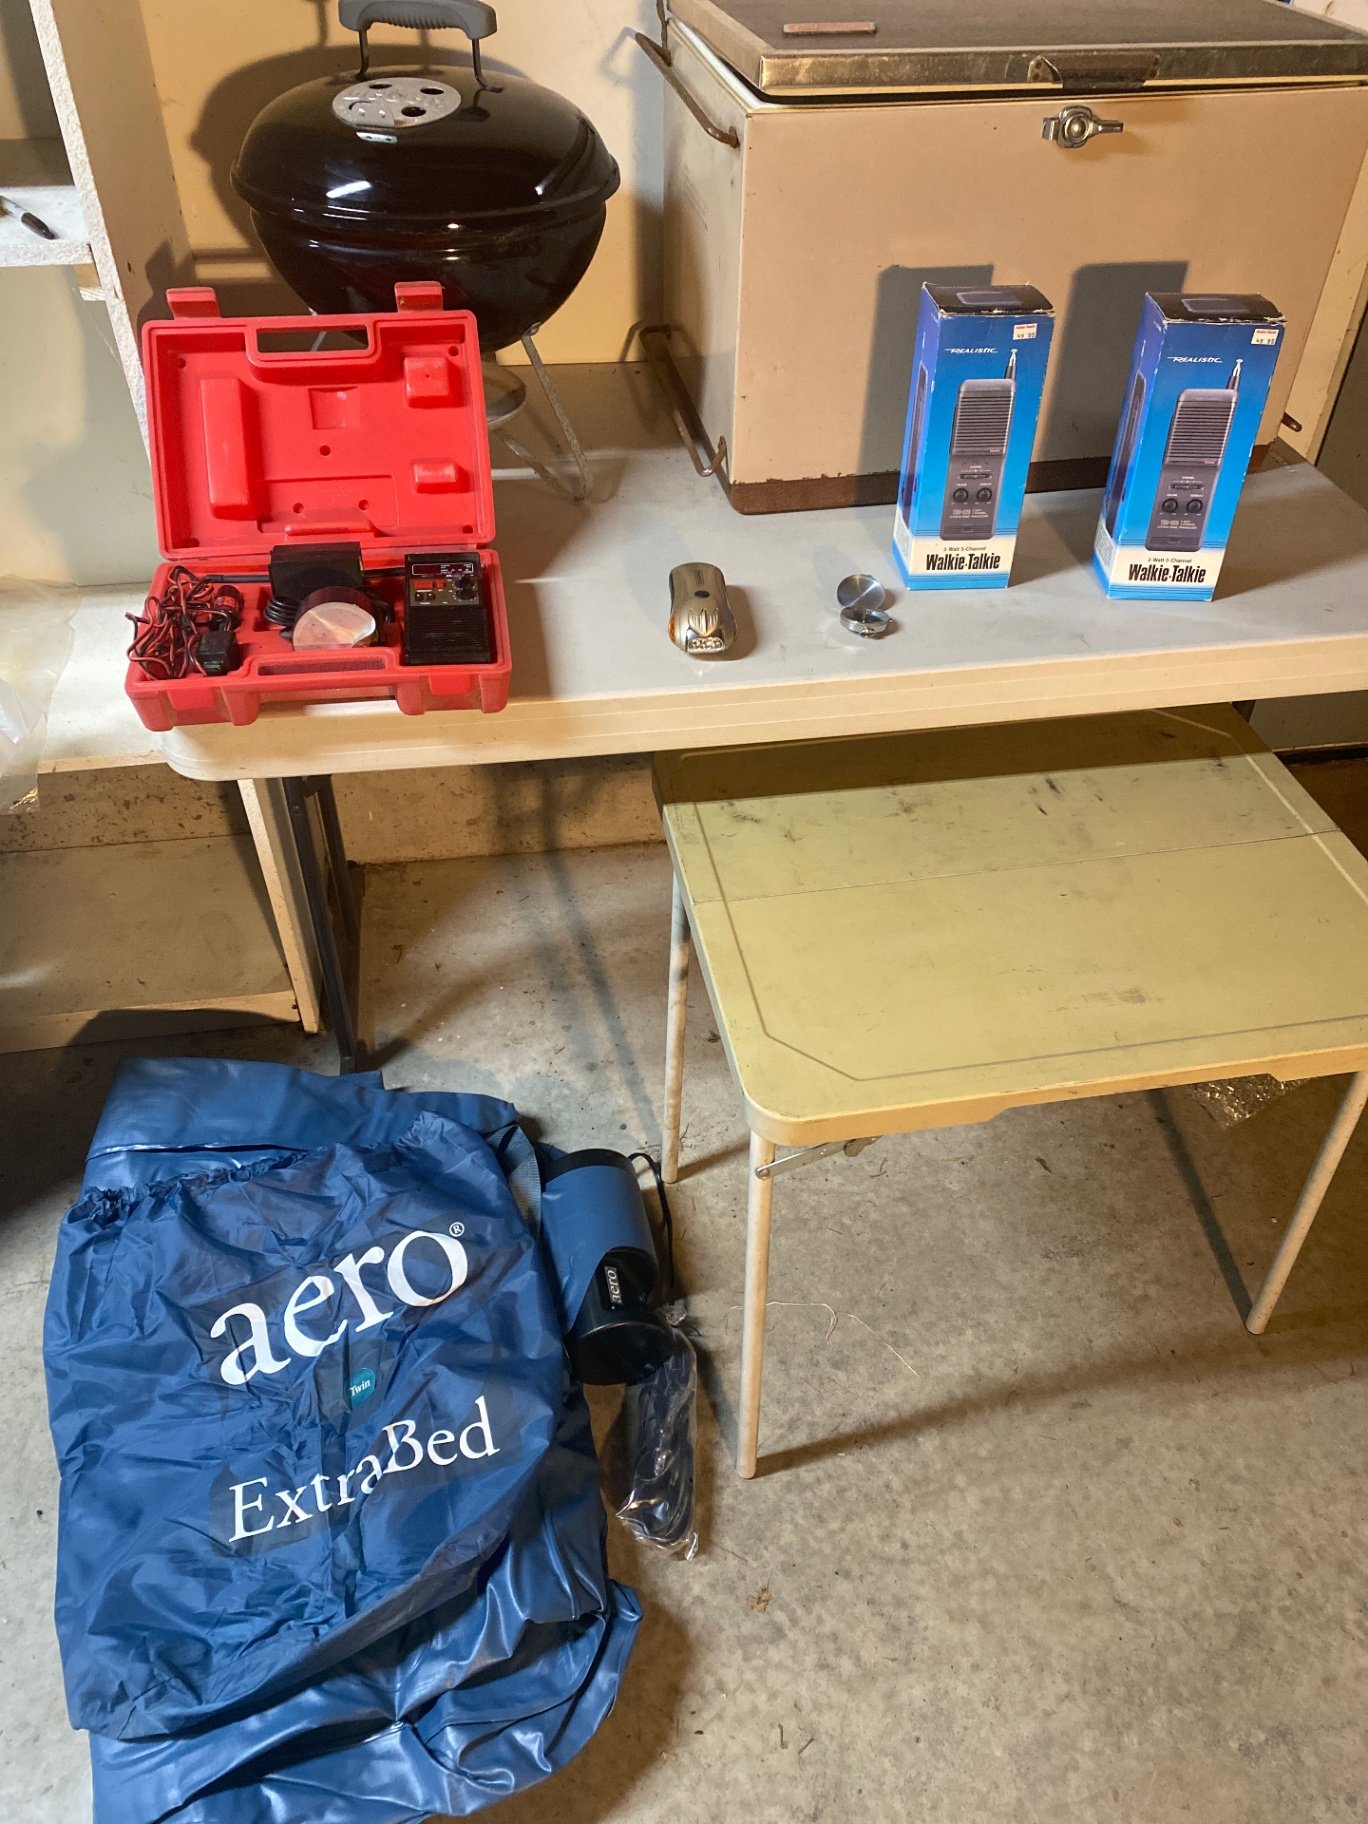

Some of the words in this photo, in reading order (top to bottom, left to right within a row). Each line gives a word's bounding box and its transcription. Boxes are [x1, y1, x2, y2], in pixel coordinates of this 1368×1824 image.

[607, 1269, 622, 1304] aero
[350, 1379, 371, 1396] Twin
[228, 1395, 500, 1543] ExtraBed
